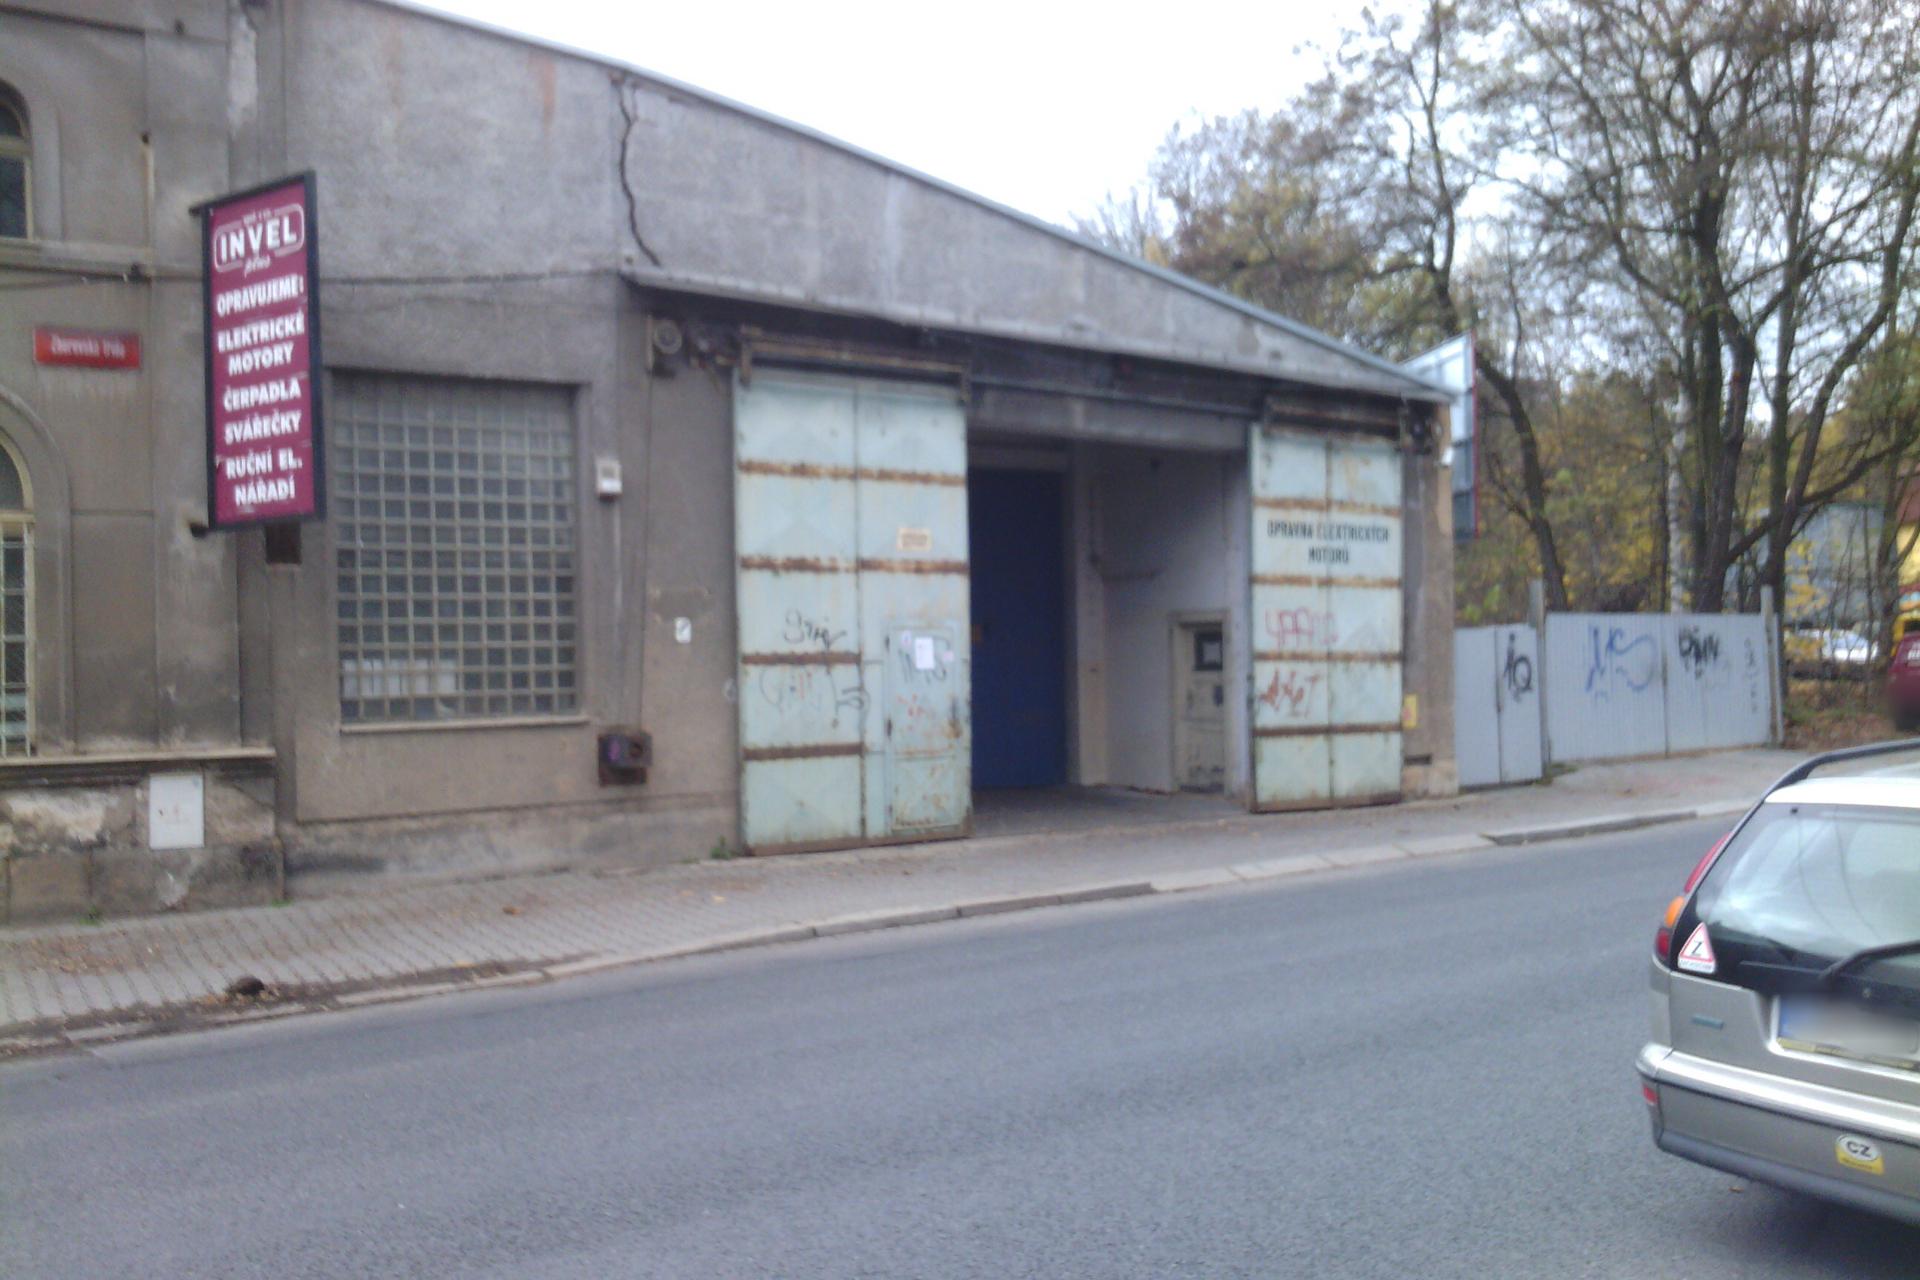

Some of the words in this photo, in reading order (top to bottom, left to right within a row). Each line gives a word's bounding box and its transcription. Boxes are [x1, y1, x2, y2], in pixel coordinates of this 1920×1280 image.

[220, 216, 297, 264] INVEL
[217, 308, 305, 353] ELEKTRICKÉ
[228, 342, 294, 377] MOTORY
[224, 377, 302, 412] ČERPADLA
[224, 410, 302, 445] SVÁŘEČKY
[226, 447, 273, 479] RUČNÍ
[279, 447, 303, 471] EL.
[235, 474, 296, 506] NÁŘADÍ
[1267, 520, 1313, 539] OPRAVNA
[1846, 1140, 1872, 1158] CZ
